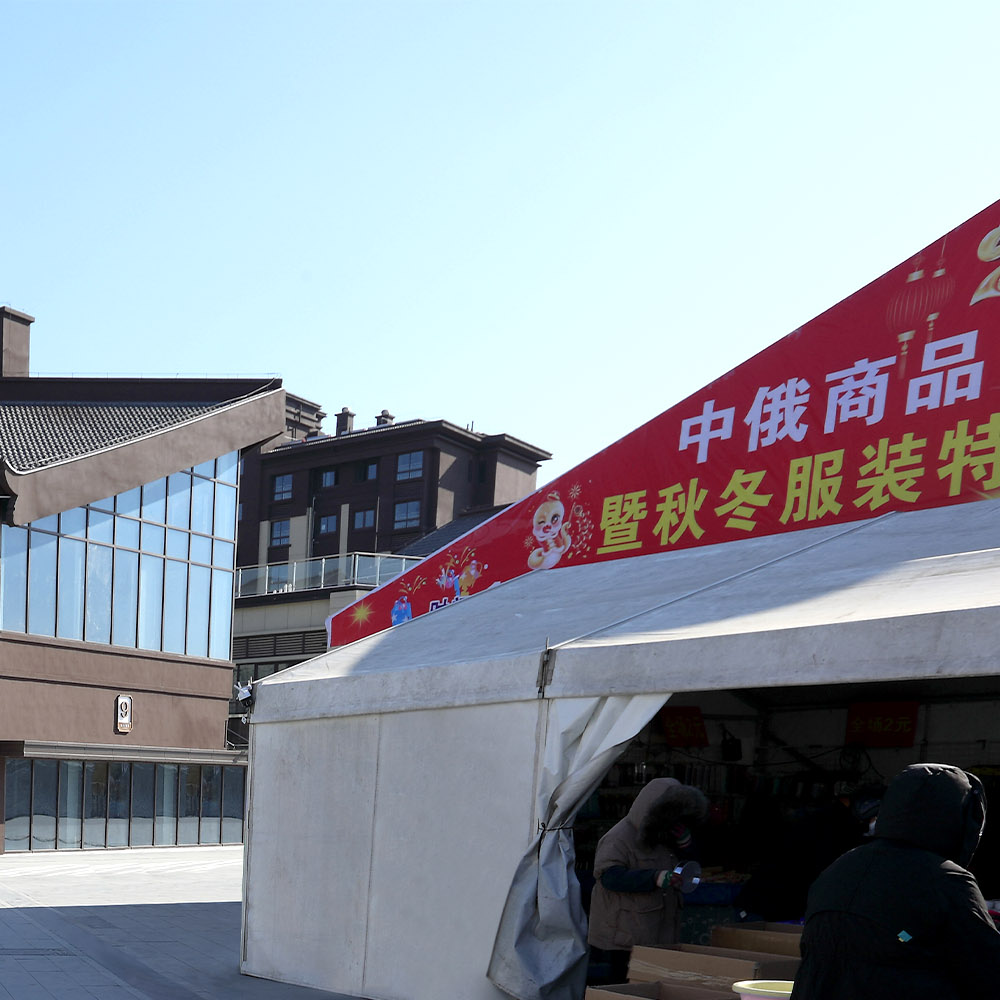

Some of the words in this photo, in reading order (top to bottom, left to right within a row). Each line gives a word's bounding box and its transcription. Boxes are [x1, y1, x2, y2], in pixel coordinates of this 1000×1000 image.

[680, 330, 985, 464] 中俄商品
[597, 413, 1000, 555] 暨秋冬服装特
